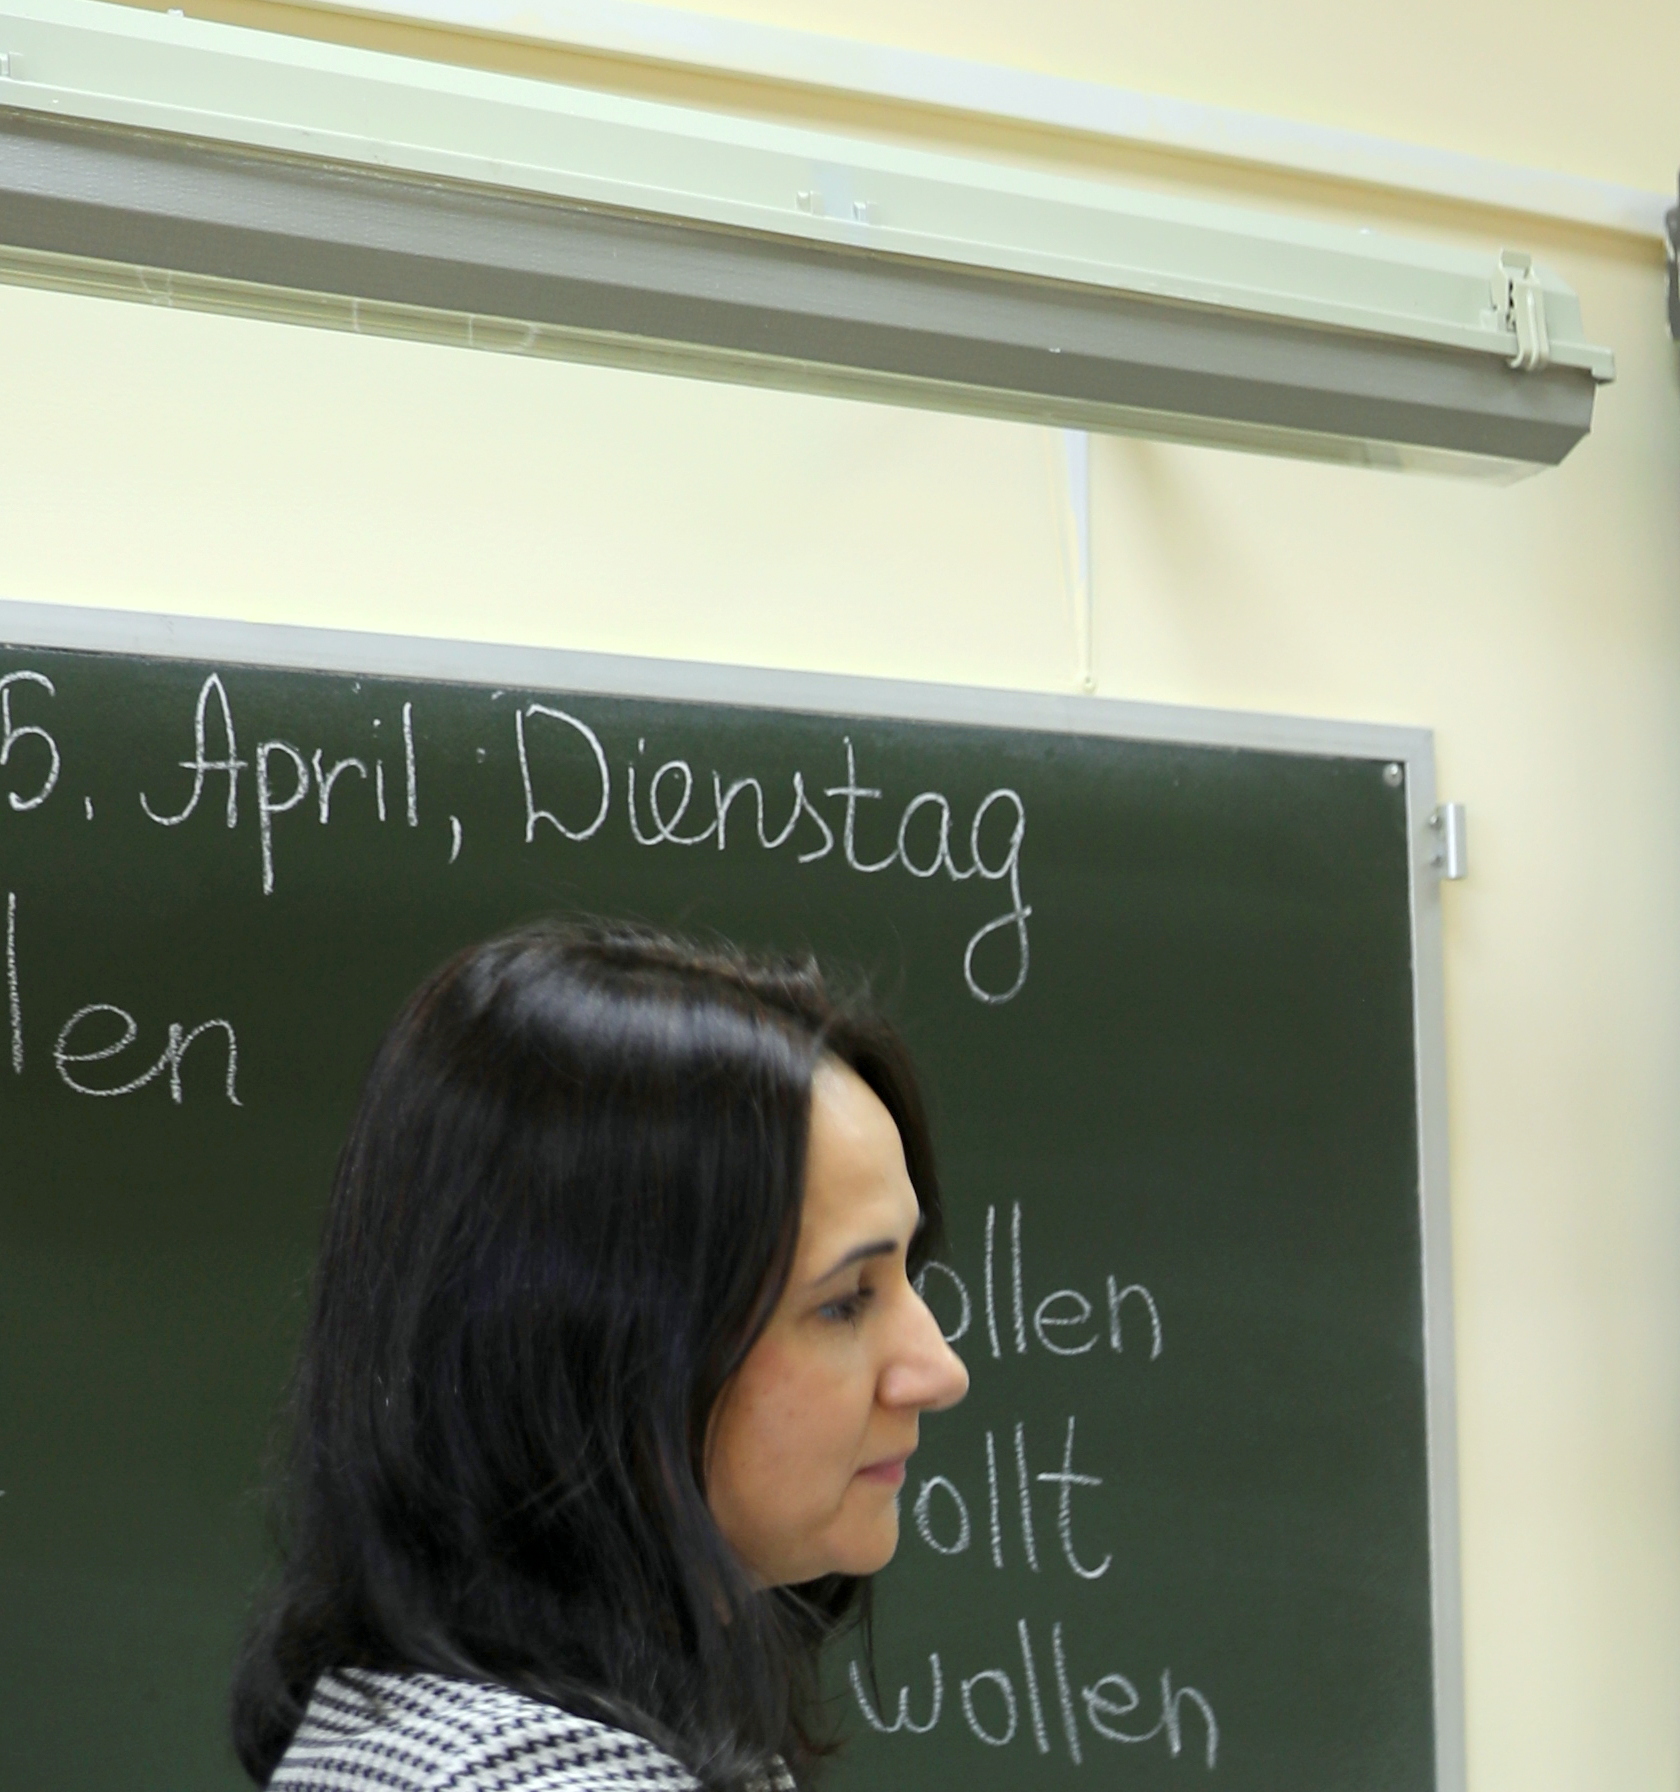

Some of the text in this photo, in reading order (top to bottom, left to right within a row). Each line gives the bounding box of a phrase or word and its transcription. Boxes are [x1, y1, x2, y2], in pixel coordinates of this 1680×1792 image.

[140, 673, 462, 894] April,
[515, 704, 1032, 1003] Dienstag
[912, 1200, 1164, 1360] ollen
[895, 1415, 1112, 1580] ollt
[850, 1618, 1220, 1771] wollen
